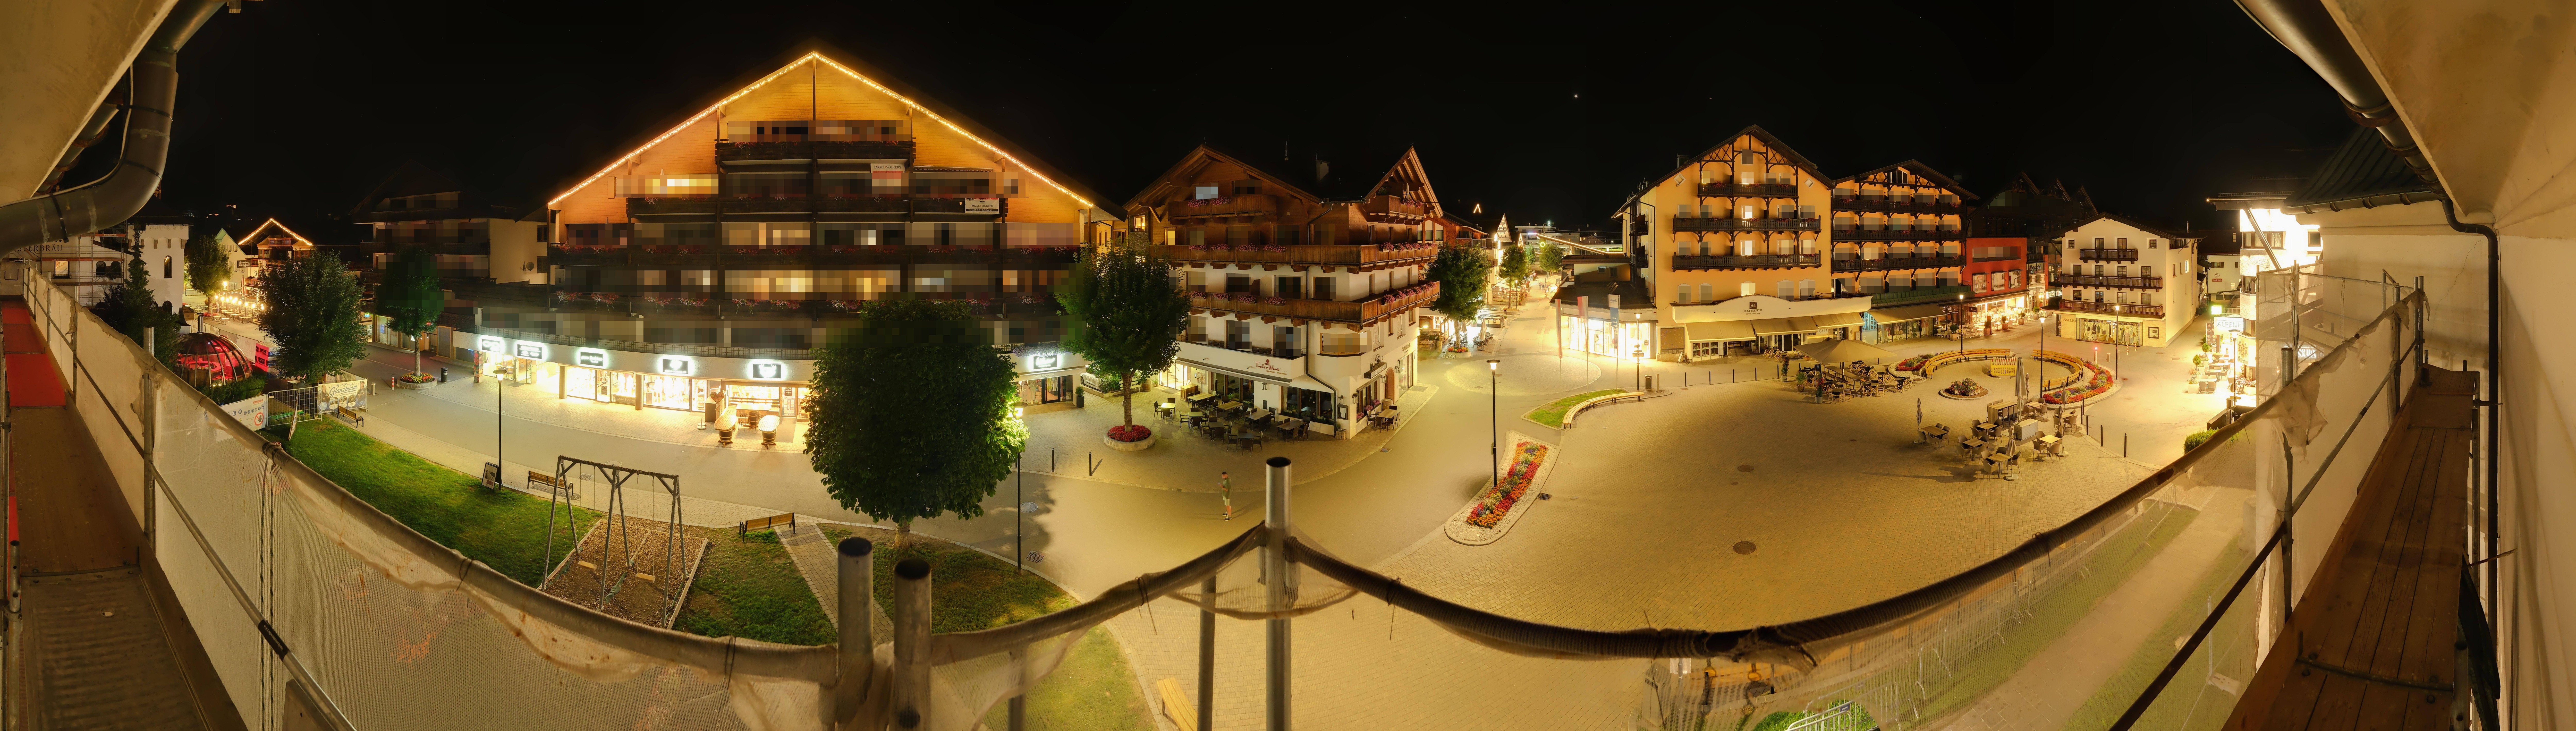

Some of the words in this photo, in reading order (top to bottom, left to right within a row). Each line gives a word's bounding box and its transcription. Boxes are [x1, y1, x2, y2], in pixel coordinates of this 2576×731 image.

[1402, 343, 1411, 351] SAILER
[1372, 364, 1386, 377] RESTAURANT
[329, 385, 358, 398] Glanzbuam
